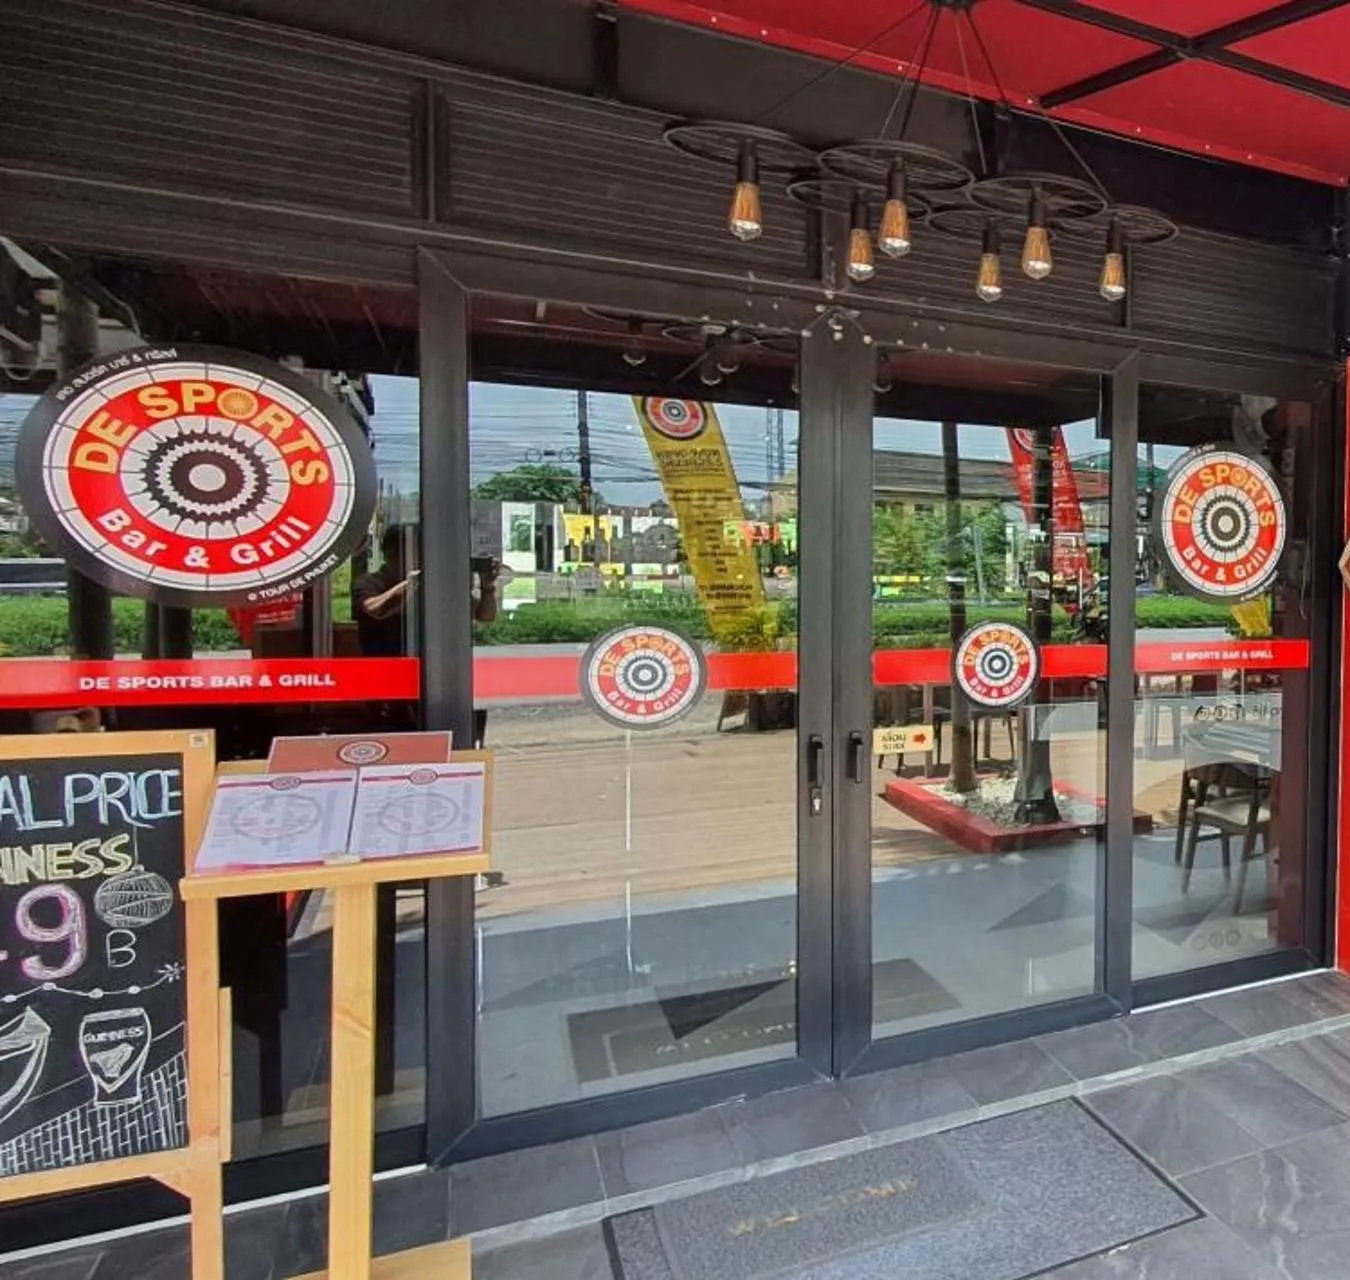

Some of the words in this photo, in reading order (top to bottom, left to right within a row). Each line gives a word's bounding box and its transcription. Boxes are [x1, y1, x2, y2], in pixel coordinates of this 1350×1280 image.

[73, 413, 138, 474] DE
[138, 382, 329, 487] SPORTS
[1174, 485, 1199, 523] DE
[1198, 464, 1275, 527] SPORTS
[97, 508, 168, 557] Bar
[183, 545, 210, 568] &
[230, 516, 311, 567] Grill
[1183, 546, 1209, 575] Bar
[1215, 567, 1226, 581] &
[1234, 547, 1267, 578] Grill
[259, 583, 290, 599] TOUR
[79, 676, 110, 690] DE
[117, 675, 204, 690] SPORTS
[210, 674, 253, 688] BAR
[258, 674, 272, 687] &
[278, 673, 336, 687] GRILL
[600, 651, 621, 677] DE
[620, 635, 690, 676] SPORTS
[64, 769, 183, 829] PRICE
